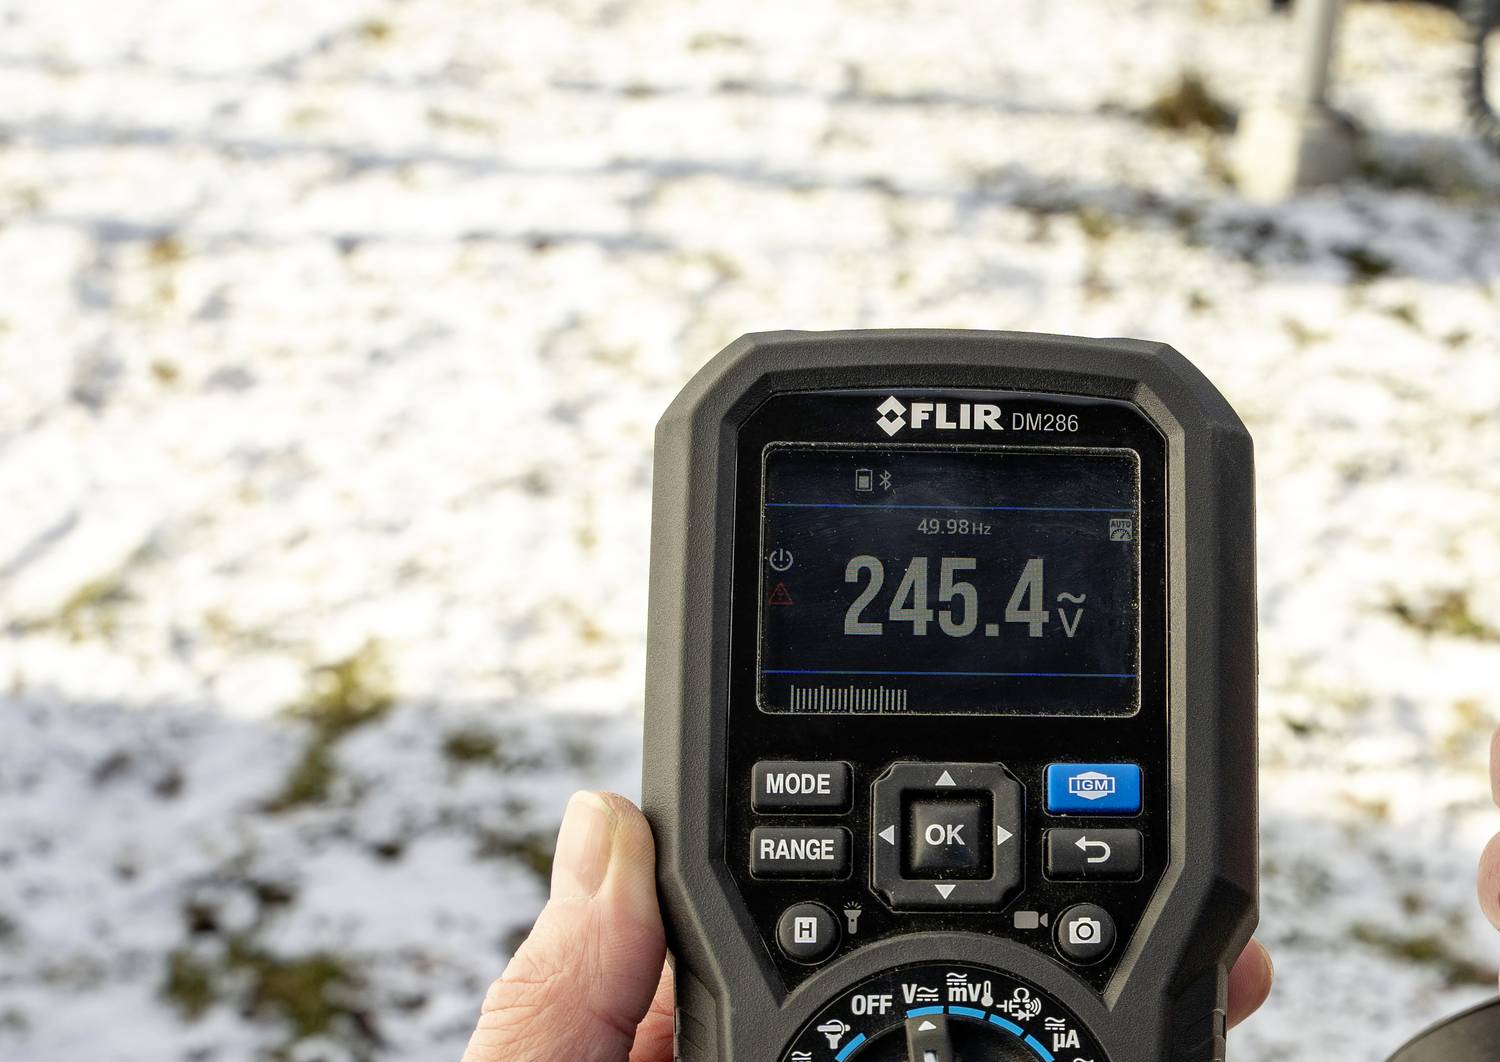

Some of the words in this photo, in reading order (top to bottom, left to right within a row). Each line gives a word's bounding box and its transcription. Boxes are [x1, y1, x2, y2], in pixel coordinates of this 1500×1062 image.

[911, 403, 1003, 430] FLIR
[1013, 413, 1078, 431] DM286
[844, 554, 1050, 638] 245.4
[767, 772, 830, 794] MODE
[1076, 778, 1109, 792] IGM
[924, 823, 966, 846] OK
[761, 839, 834, 860] RANGE
[852, 995, 892, 1015] OFF
